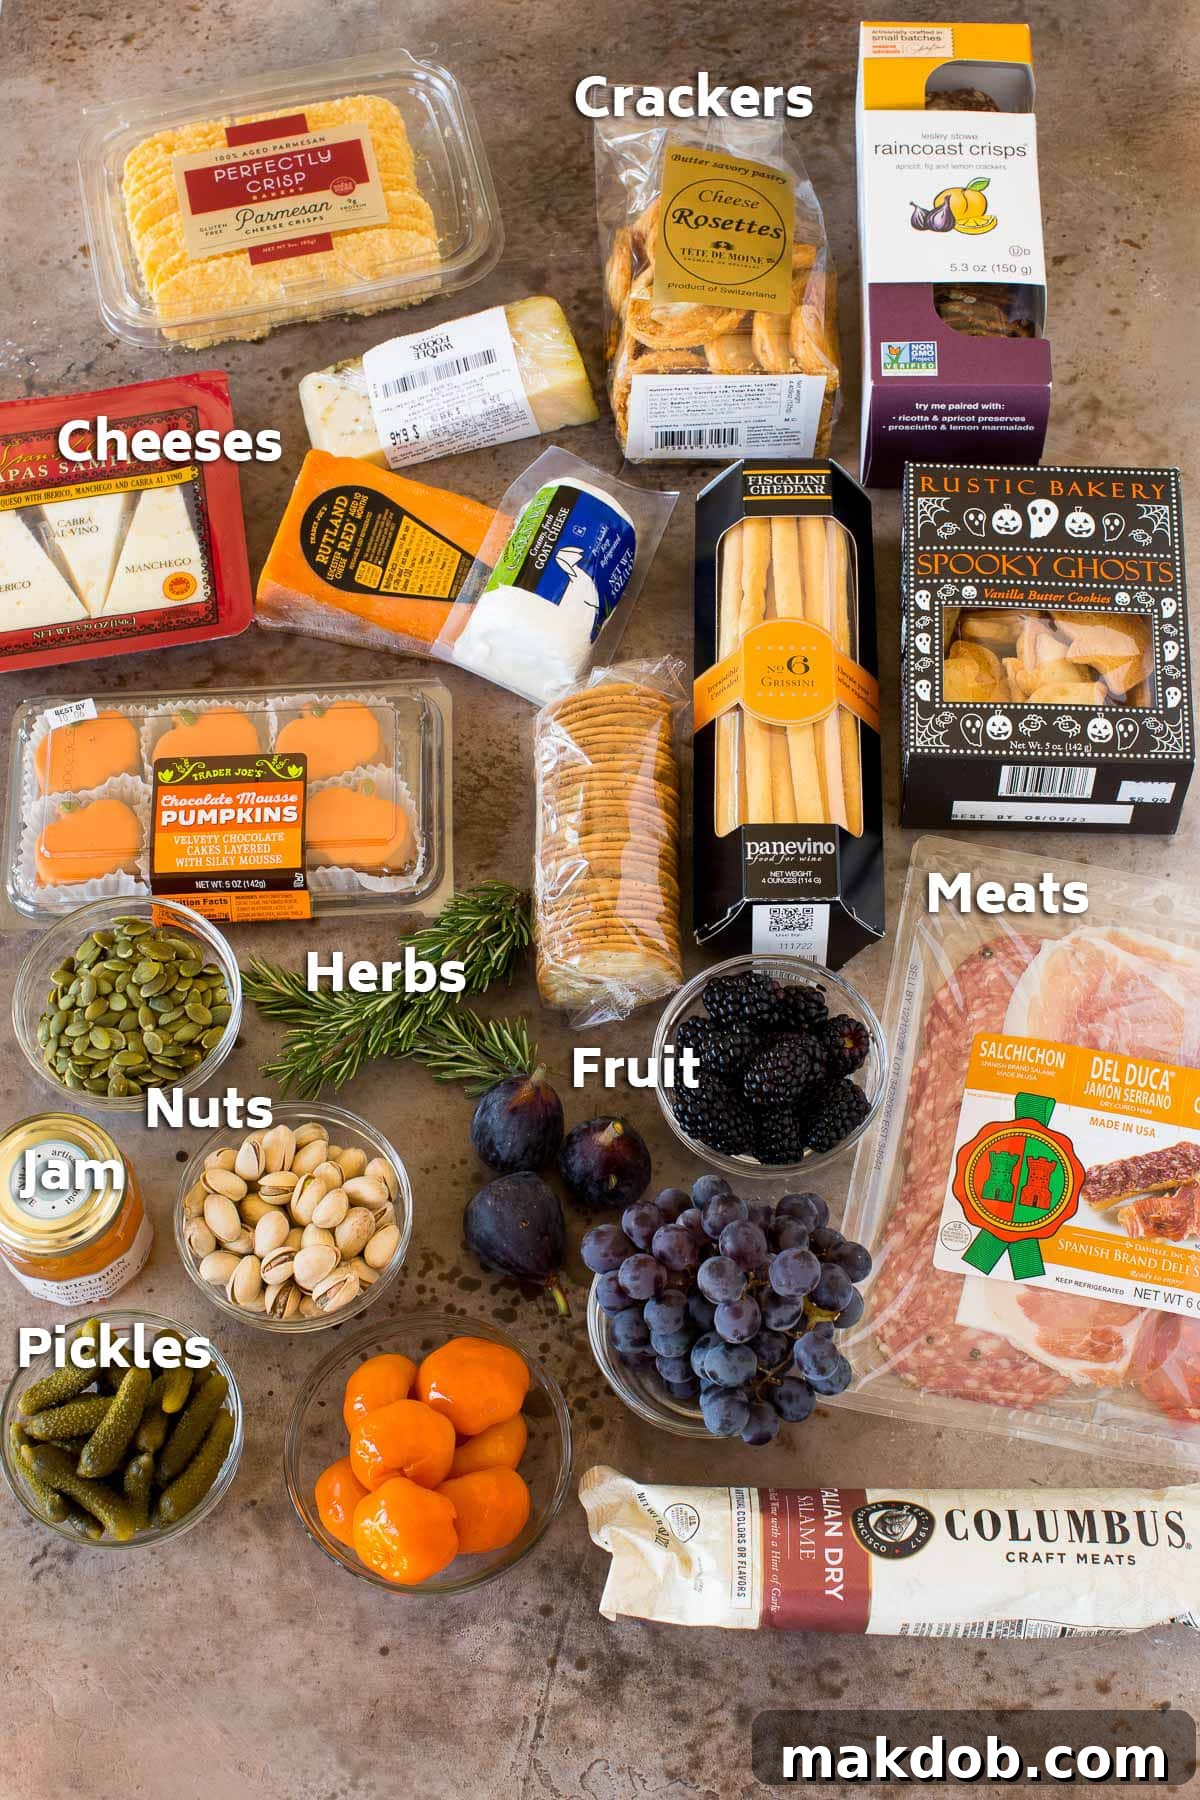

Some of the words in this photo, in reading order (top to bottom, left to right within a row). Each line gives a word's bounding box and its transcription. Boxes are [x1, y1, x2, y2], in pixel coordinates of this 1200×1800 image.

[215, 153, 237, 162] 100%
[242, 147, 269, 157] AGED
[272, 136, 326, 151] PARMESAN
[874, 140, 963, 155] raincoast
[969, 142, 1027, 159] crisps
[214, 149, 332, 183] PERFECTLY
[671, 153, 710, 167] Butter
[712, 160, 749, 176] savory
[749, 168, 788, 185] pastry
[246, 172, 306, 194] CRISP
[252, 187, 304, 200] BAKERY
[698, 189, 761, 210] Cheese
[235, 201, 332, 232] Parmesan
[244, 222, 283, 235] CHEESE
[288, 215, 324, 226] CRISPS
[671, 207, 785, 240] Rosettes
[199, 223, 227, 233] GLUTEN
[205, 229, 223, 237] FREE
[728, 252, 764, 265] MOINE
[950, 263, 969, 273] 5.3
[972, 265, 987, 273] oz
[991, 263, 1017, 274] (150
[1020, 265, 1032, 276] g)
[667, 282, 705, 293] Product
[707, 284, 718, 293] of
[720, 286, 777, 301] Switzerland
[414, 343, 454, 360] WHOLE
[915, 402, 929, 411] try
[948, 402, 979, 411] paired
[981, 402, 1006, 410] with:
[888, 423, 937, 432] prosciutto
[898, 414, 929, 422] ricotta
[941, 414, 976, 423] apricot
[978, 415, 1026, 423] preserves
[389, 428, 409, 446] 6.46
[24, 494, 42, 502] WITH
[44, 489, 73, 500] IBERICO,
[75, 484, 112, 494] MANCHEGO
[115, 481, 128, 489] AND
[131, 476, 153, 487] CABRA
[167, 472, 183, 482] VINO
[748, 475, 826, 486] FISCALINI
[750, 484, 825, 495] CHEDDAR
[920, 475, 1037, 496] RUSTIC
[1050, 480, 1166, 500] BAKERY
[355, 494, 369, 520] MONTHS
[57, 516, 93, 528] CABRA
[315, 495, 348, 565] RUTLAND
[338, 522, 357, 552] RED
[534, 540, 554, 570] GOAT
[549, 507, 570, 544] CHEESE
[125, 557, 192, 574] MANCHEGO
[334, 558, 347, 579] CHEESE
[605, 564, 625, 587] NET
[917, 553, 1044, 577] SPOOKY
[1053, 557, 1174, 584] GHOSTS
[983, 587, 1025, 600] Vanilla
[1027, 588, 1065, 602] Butter
[1067, 591, 1111, 605] Cookies
[33, 630, 52, 639] NET
[786, 655, 810, 676] 6
[760, 676, 815, 687] GRISSINI
[54, 706, 73, 716] BEST
[1028, 741, 1043, 749] Wt.
[1065, 743, 1083, 752] (142
[1084, 743, 1092, 753] g)
[192, 768, 232, 782] TRADER
[234, 768, 264, 778] JOE'S
[161, 793, 233, 807] Chocolate
[236, 791, 298, 805] Mousse
[161, 805, 298, 826] PUMPKINS
[174, 834, 220, 845] VELVETY
[222, 832, 285, 843] CHOCOLATE
[745, 837, 836, 860] panevino
[186, 845, 221, 856] CAKES
[223, 843, 271, 854] LAYERED
[775, 854, 795, 865] for
[175, 857, 203, 868] WITH
[205, 856, 236, 866] SILKY
[239, 854, 283, 865] MOUSSE
[195, 880, 210, 889] NET
[225, 880, 231, 888] 5
[231, 880, 242, 888] OZ
[243, 879, 266, 889] (142g)
[202, 897, 228, 905] Facts
[979, 1040, 1066, 1069] SALCHICHON
[892, 1056, 903, 1075] LOT
[1008, 1063, 1030, 1072] BRAND
[1090, 1056, 1121, 1083] DEL
[1124, 1061, 1170, 1092] DUCA
[1083, 1078, 1121, 1101] JAMÓN
[1123, 1087, 1172, 1110] SERRANO
[1089, 1116, 1120, 1130] MADE
[1122, 1121, 1133, 1132] IN
[1135, 1123, 1157, 1138] USA
[1057, 1239, 1111, 1261] SPANISH
[1114, 1247, 1158, 1270] BRAND
[1161, 1259, 1190, 1275] DELI
[1055, 1276, 1074, 1286] KEEP
[1073, 1279, 1125, 1296] REFRIGERATED
[1132, 1286, 1161, 1301] NET
[1163, 1291, 1184, 1306] WT
[1186, 1297, 1194, 1308] 6
[736, 1510, 746, 1544] COLORS
[770, 1517, 781, 1538] with
[797, 1495, 816, 1561] SALAME
[856, 1510, 887, 1552] FRANCISCO
[944, 1508, 1186, 1549] COLUMBUS
[737, 1547, 746, 1557] OR
[771, 1550, 781, 1572] Hint
[1005, 1551, 1067, 1565] CRAFT
[1076, 1553, 1137, 1566] MEATS
[737, 1560, 747, 1598] FLAVORS
[824, 1548, 844, 1601] DRY
